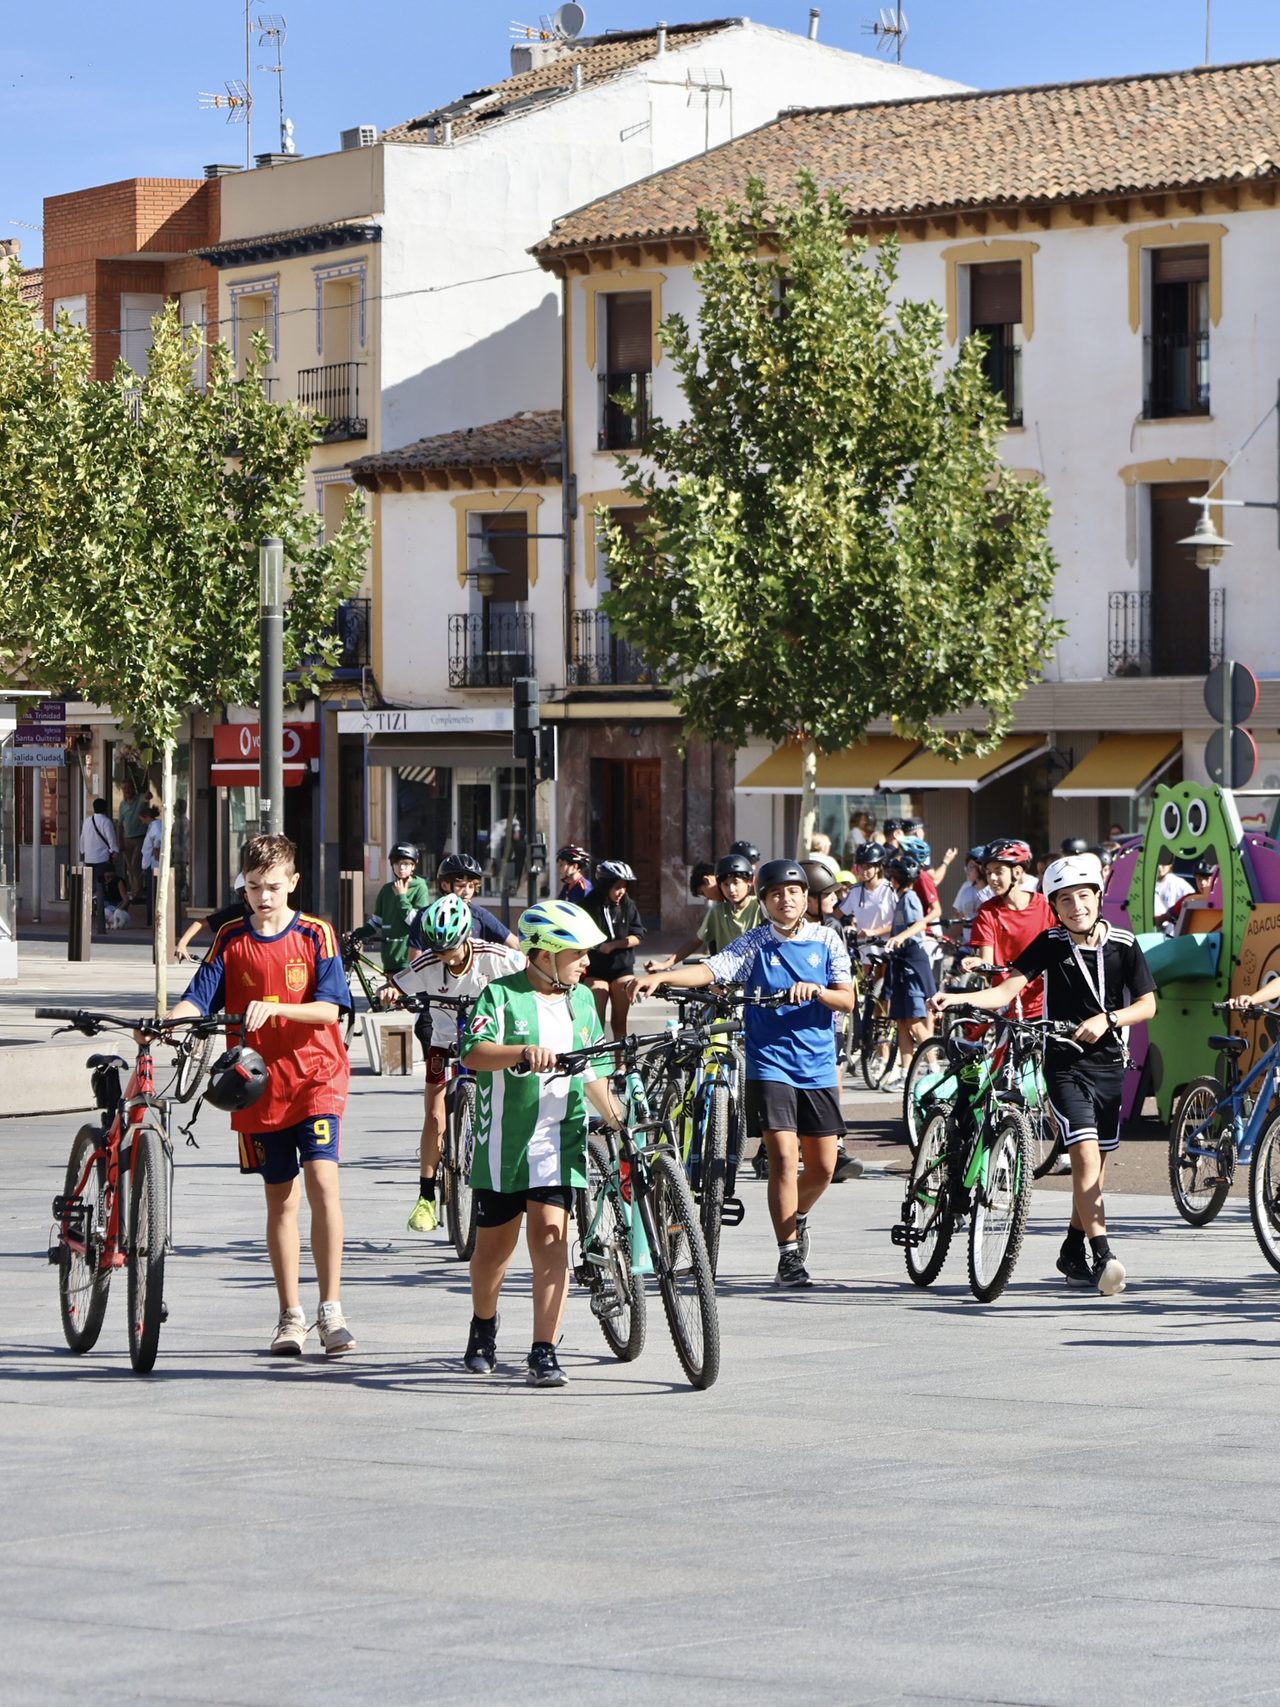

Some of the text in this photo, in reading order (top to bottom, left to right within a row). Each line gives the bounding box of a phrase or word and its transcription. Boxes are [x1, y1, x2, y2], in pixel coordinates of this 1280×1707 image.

[35, 711, 61, 720] Trinidad
[375, 713, 408, 731] TIZI
[15, 734, 34, 742] Santa
[36, 752, 62, 761] Ciudad
[313, 1118, 331, 1146] 9
